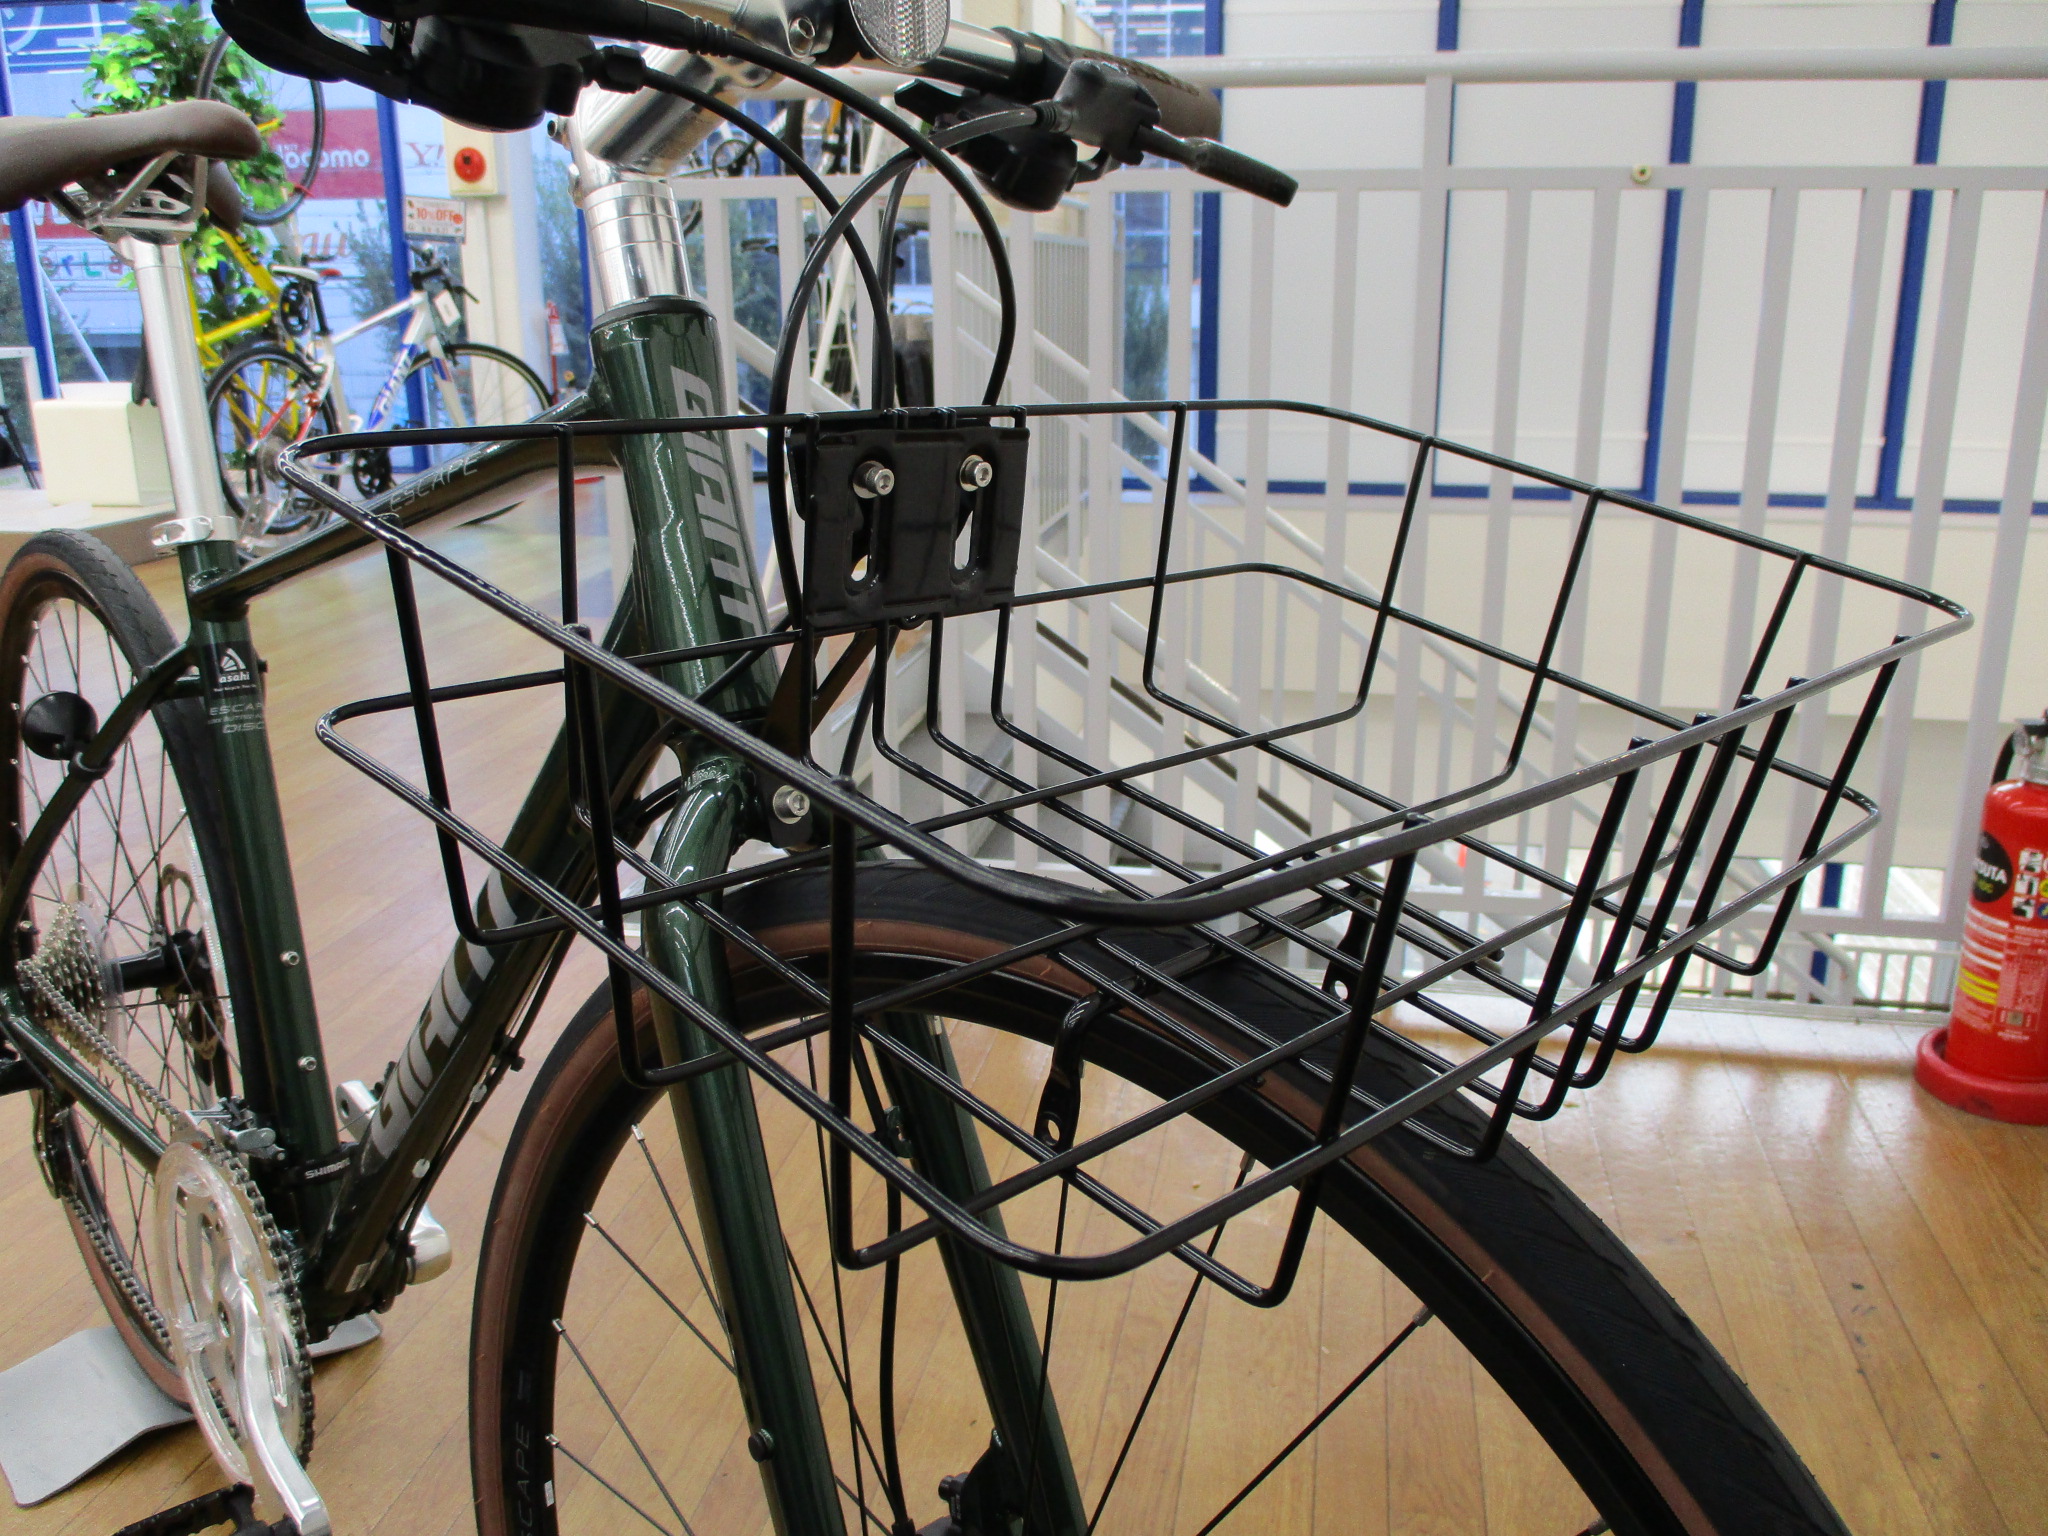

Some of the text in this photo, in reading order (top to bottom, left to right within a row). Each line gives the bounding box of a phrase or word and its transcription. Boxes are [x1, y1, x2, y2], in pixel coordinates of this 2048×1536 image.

[391, 450, 482, 512] ESCAPE
[670, 365, 771, 636] GIANT
[219, 671, 250, 684] asahi
